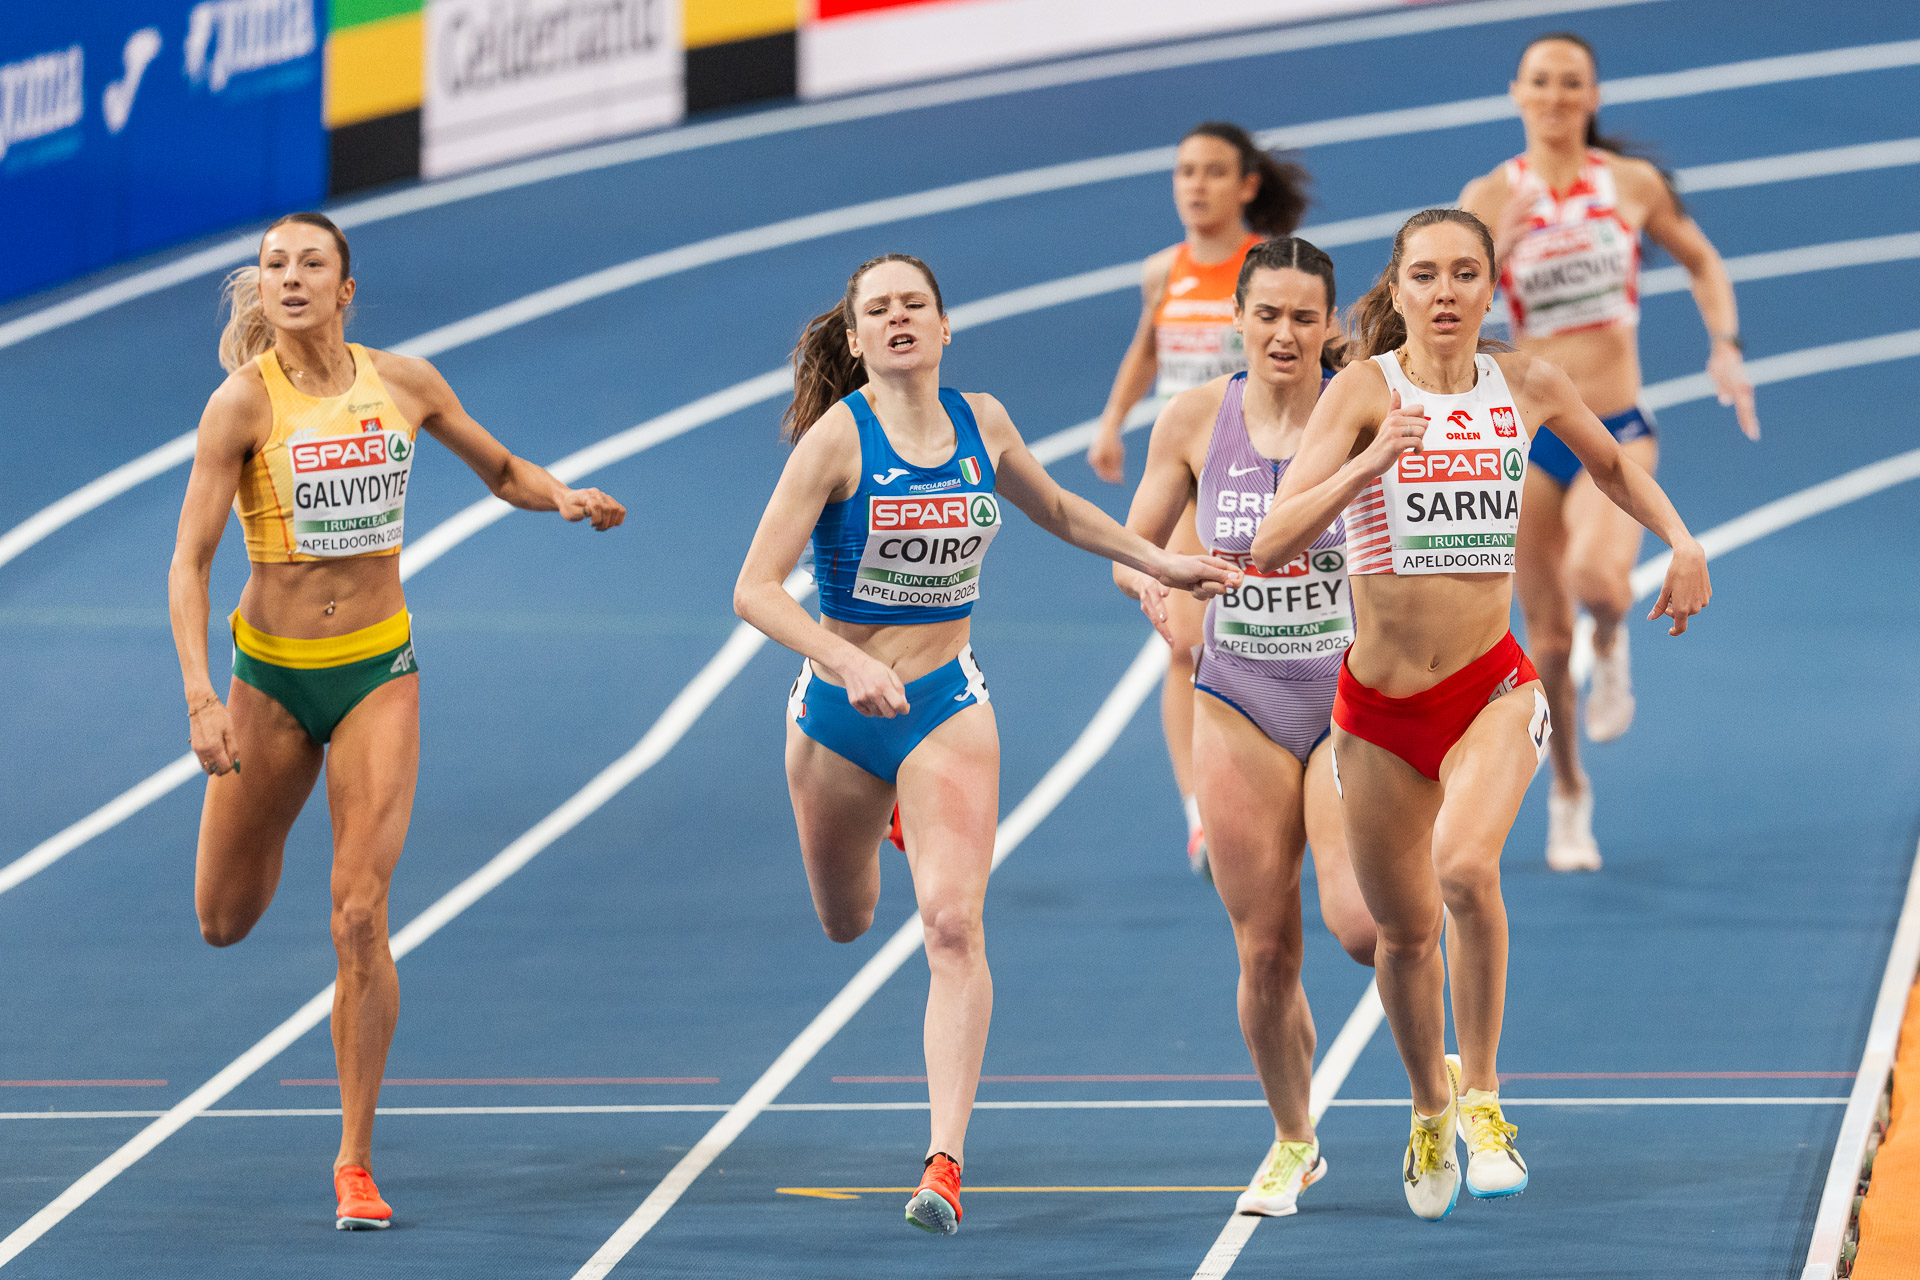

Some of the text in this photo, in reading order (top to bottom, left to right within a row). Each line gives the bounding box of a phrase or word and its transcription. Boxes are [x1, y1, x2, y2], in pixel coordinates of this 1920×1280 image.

[1446, 432, 1481, 440] ORLEN
[295, 438, 385, 470] SPAR
[1401, 453, 1498, 479] SPAR
[295, 469, 408, 509] GALVYDYTE
[909, 478, 962, 491] FRECCIAROSSA
[875, 501, 965, 526] SPAR
[1406, 490, 1519, 522] SARNA
[324, 520, 328, 532] I
[330, 517, 357, 531] RUN
[302, 532, 385, 551] APELDOORN
[878, 535, 982, 565] COIRO
[1428, 536, 1432, 548] I
[1435, 535, 1465, 547] RUN
[1402, 553, 1501, 569] APELDOORN
[887, 572, 891, 582] I
[893, 573, 923, 586] RUN
[858, 582, 976, 603] APELDOORN 2025
[1222, 579, 1342, 613] BOFFEY
[1249, 625, 1276, 637] RUN
[1221, 636, 1350, 655] APELDOORN 2025
